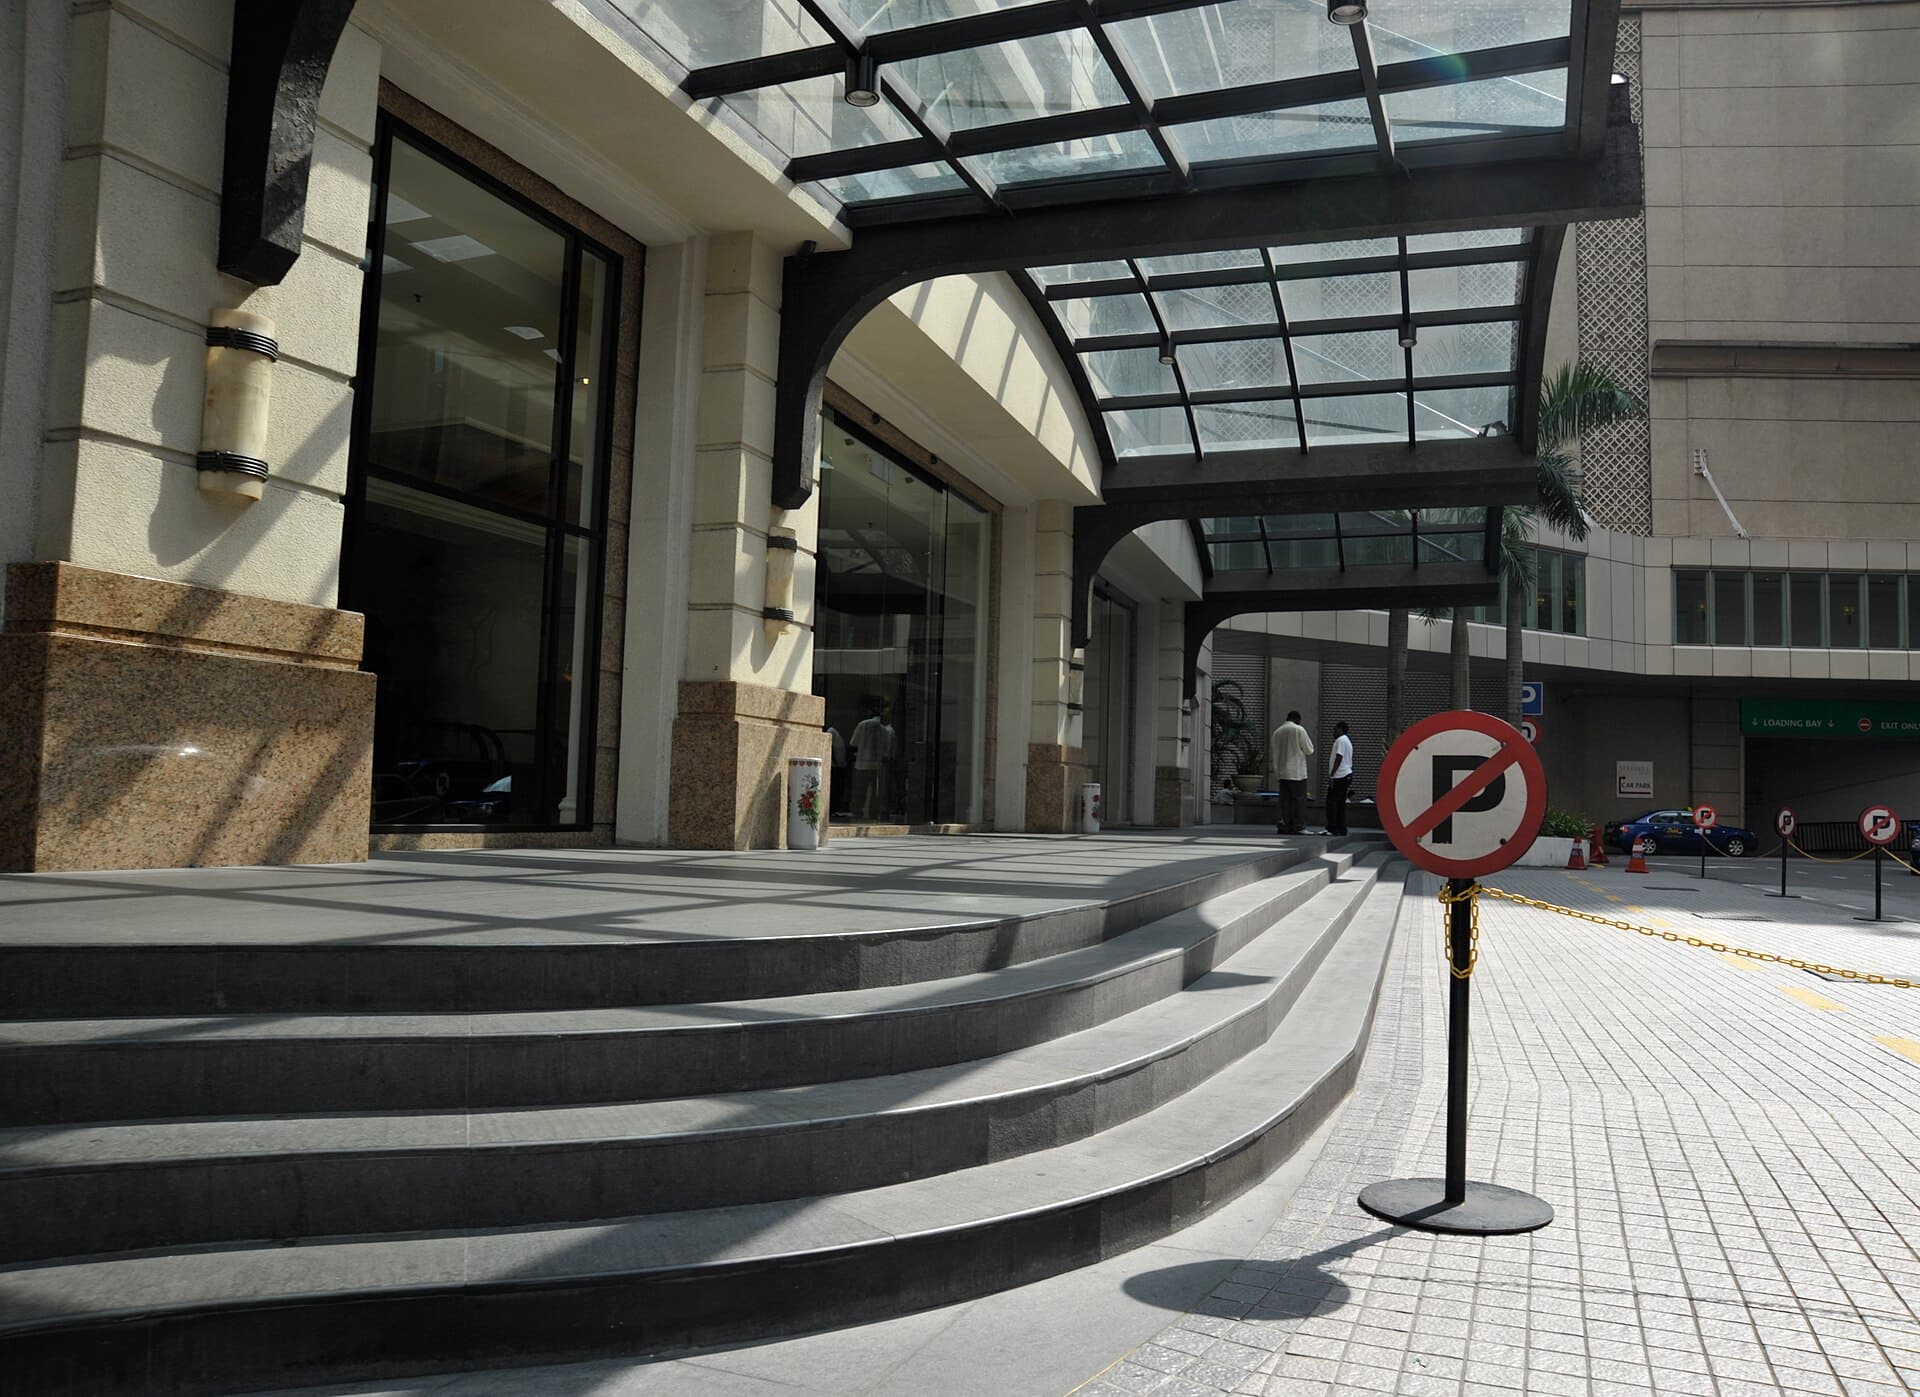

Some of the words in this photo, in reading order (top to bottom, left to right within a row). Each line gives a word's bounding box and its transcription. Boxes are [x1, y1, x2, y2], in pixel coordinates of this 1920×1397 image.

[1763, 719, 1803, 727] LOADING
[1805, 720, 1822, 728] BAY
[1880, 721, 1898, 729] EXIT
[1432, 755, 1506, 844] P
[1700, 810, 1712, 825] P
[1872, 815, 1890, 836] P
